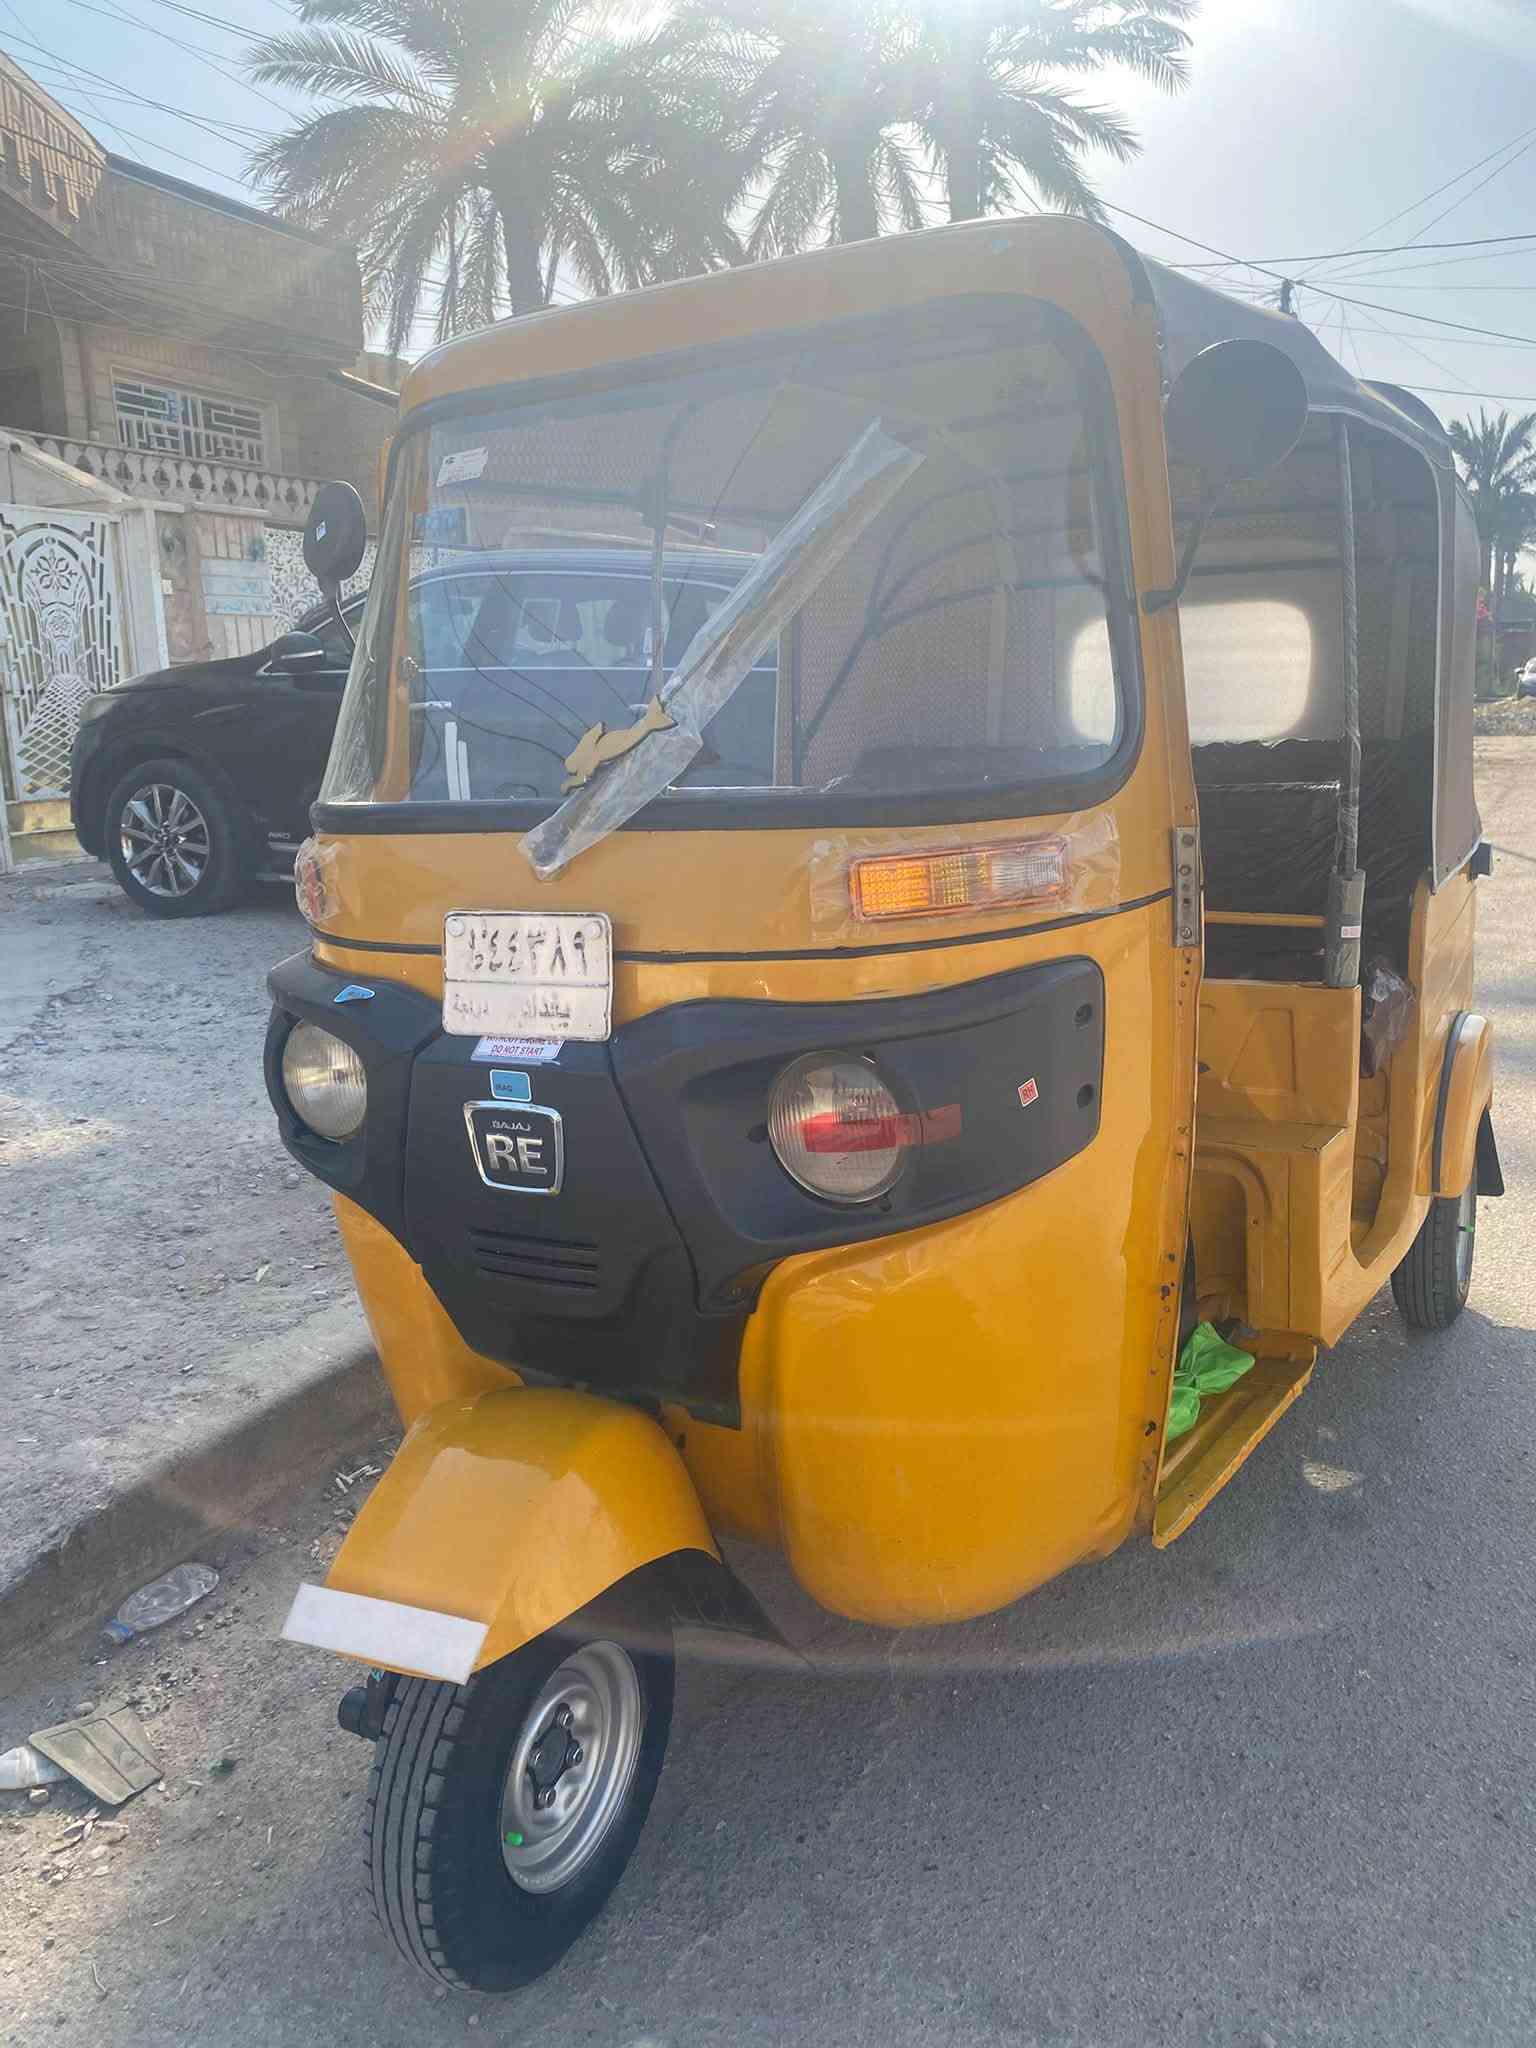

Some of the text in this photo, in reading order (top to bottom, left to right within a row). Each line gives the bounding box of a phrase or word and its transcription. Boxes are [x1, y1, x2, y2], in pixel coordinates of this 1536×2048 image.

[491, 1044, 544, 1056] DO NOT START
[491, 1119, 532, 1132] BAJAJ
[485, 1132, 548, 1175] RE
